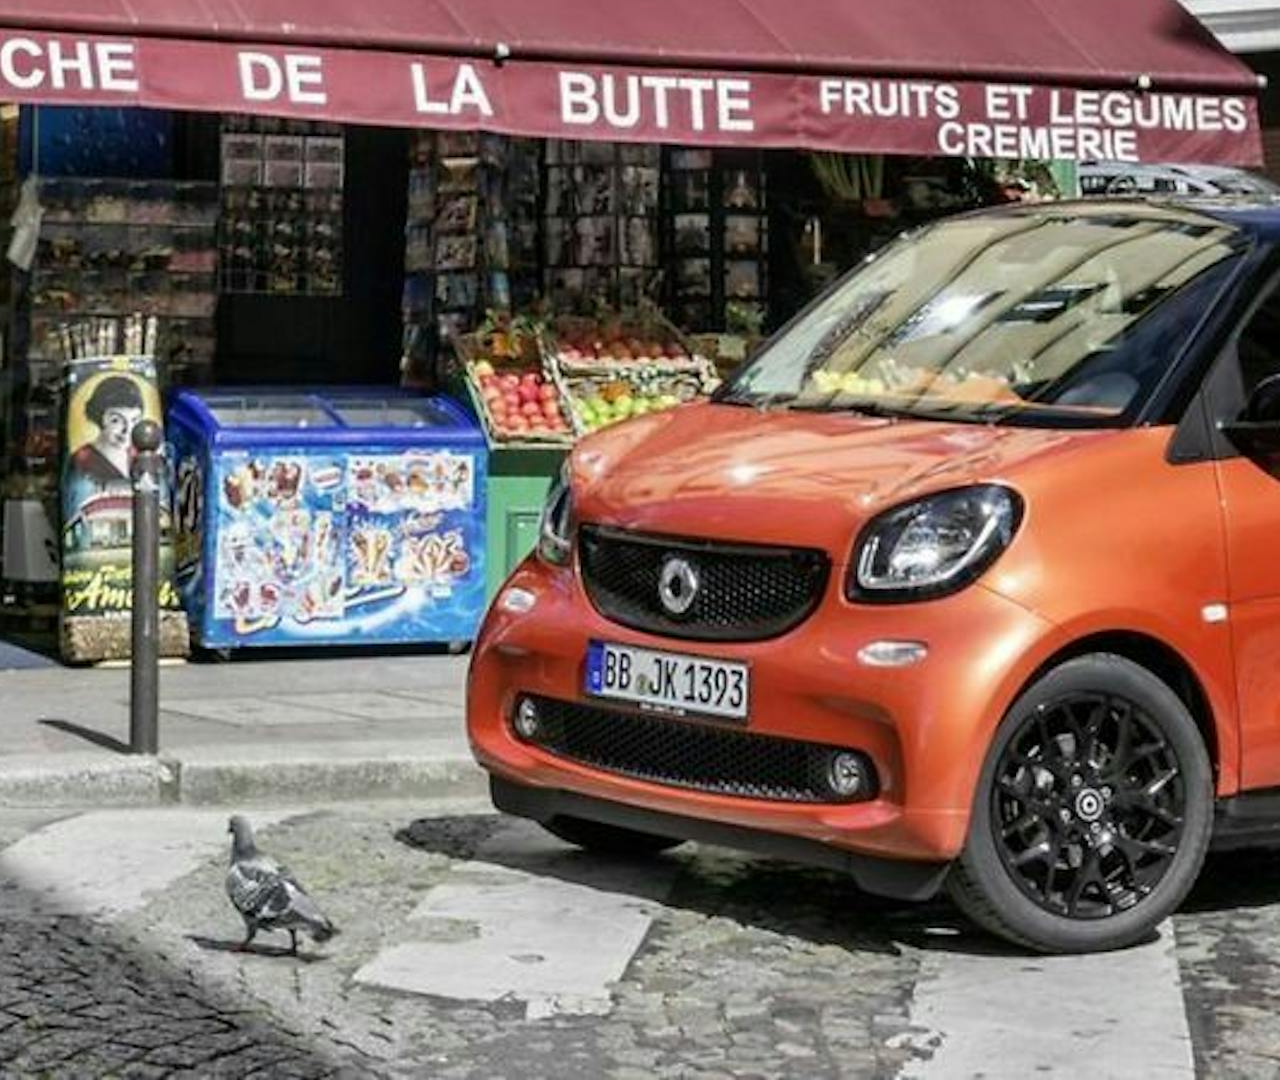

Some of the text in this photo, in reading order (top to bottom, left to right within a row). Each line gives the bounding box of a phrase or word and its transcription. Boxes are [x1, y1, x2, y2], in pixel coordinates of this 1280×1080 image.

[237, 51, 327, 105] DE
[410, 63, 494, 117] LA
[558, 70, 755, 132] BUTTE
[819, 79, 1247, 132] FRUITS ET LEGUMES
[937, 122, 1139, 162] CREMERIE
[604, 651, 744, 708] BB JK 1393
